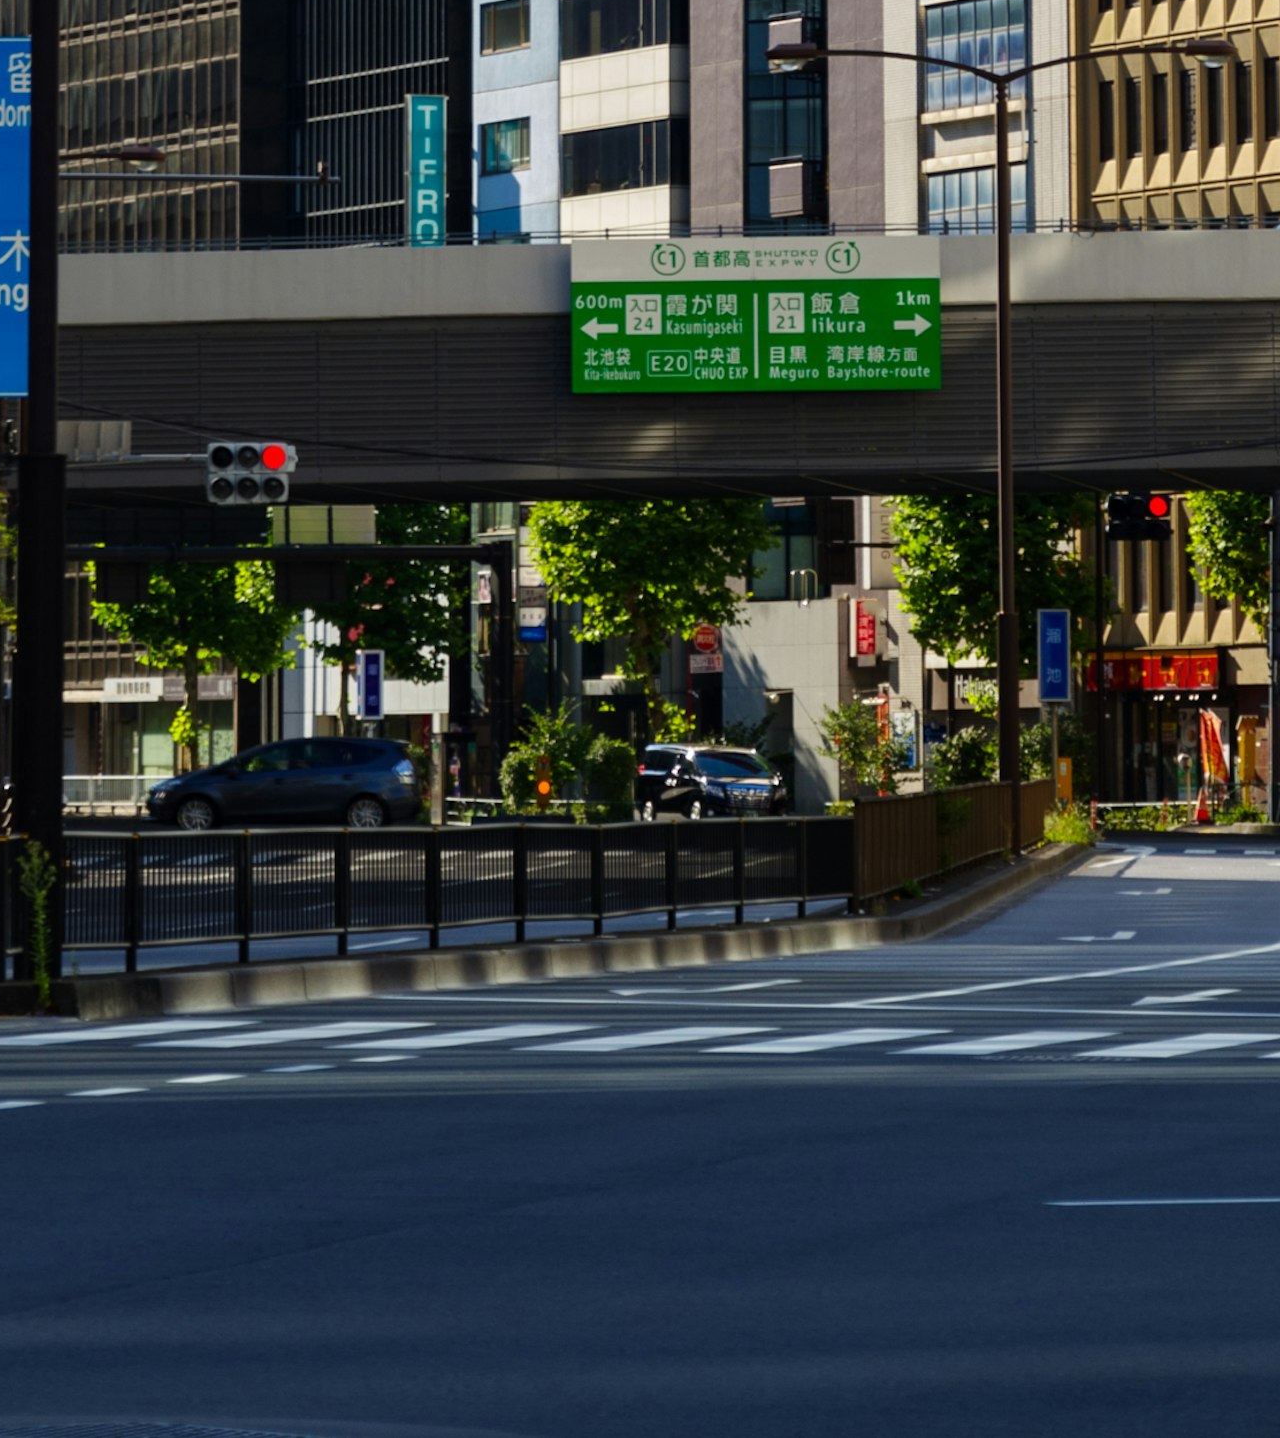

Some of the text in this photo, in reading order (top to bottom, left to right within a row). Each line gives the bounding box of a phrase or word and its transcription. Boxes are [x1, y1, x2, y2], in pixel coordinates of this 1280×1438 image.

[657, 250, 677, 269] C1
[693, 250, 750, 268] 首都高
[754, 249, 818, 258] SHUTOKO
[832, 248, 851, 267] C1
[756, 259, 816, 267] EXPWY
[575, 294, 623, 309] 600m
[630, 298, 658, 313] 入口
[666, 293, 738, 316] 霞が関
[772, 296, 801, 311] 入口
[811, 291, 860, 315] 飯倉
[896, 289, 931, 306] 1km
[633, 317, 654, 331] 24
[666, 318, 743, 338] Kasumigaseki
[776, 315, 797, 330] 21
[812, 317, 866, 334] Iikura
[584, 348, 631, 366] 北池袋
[694, 346, 741, 365] 中央道
[770, 345, 807, 364] 目黒
[827, 345, 918, 364] 湾岸線方面
[651, 355, 688, 372] E20
[694, 366, 749, 380] CHUO EXP
[769, 366, 820, 382] Meguro
[827, 365, 931, 381] Bayshore-route
